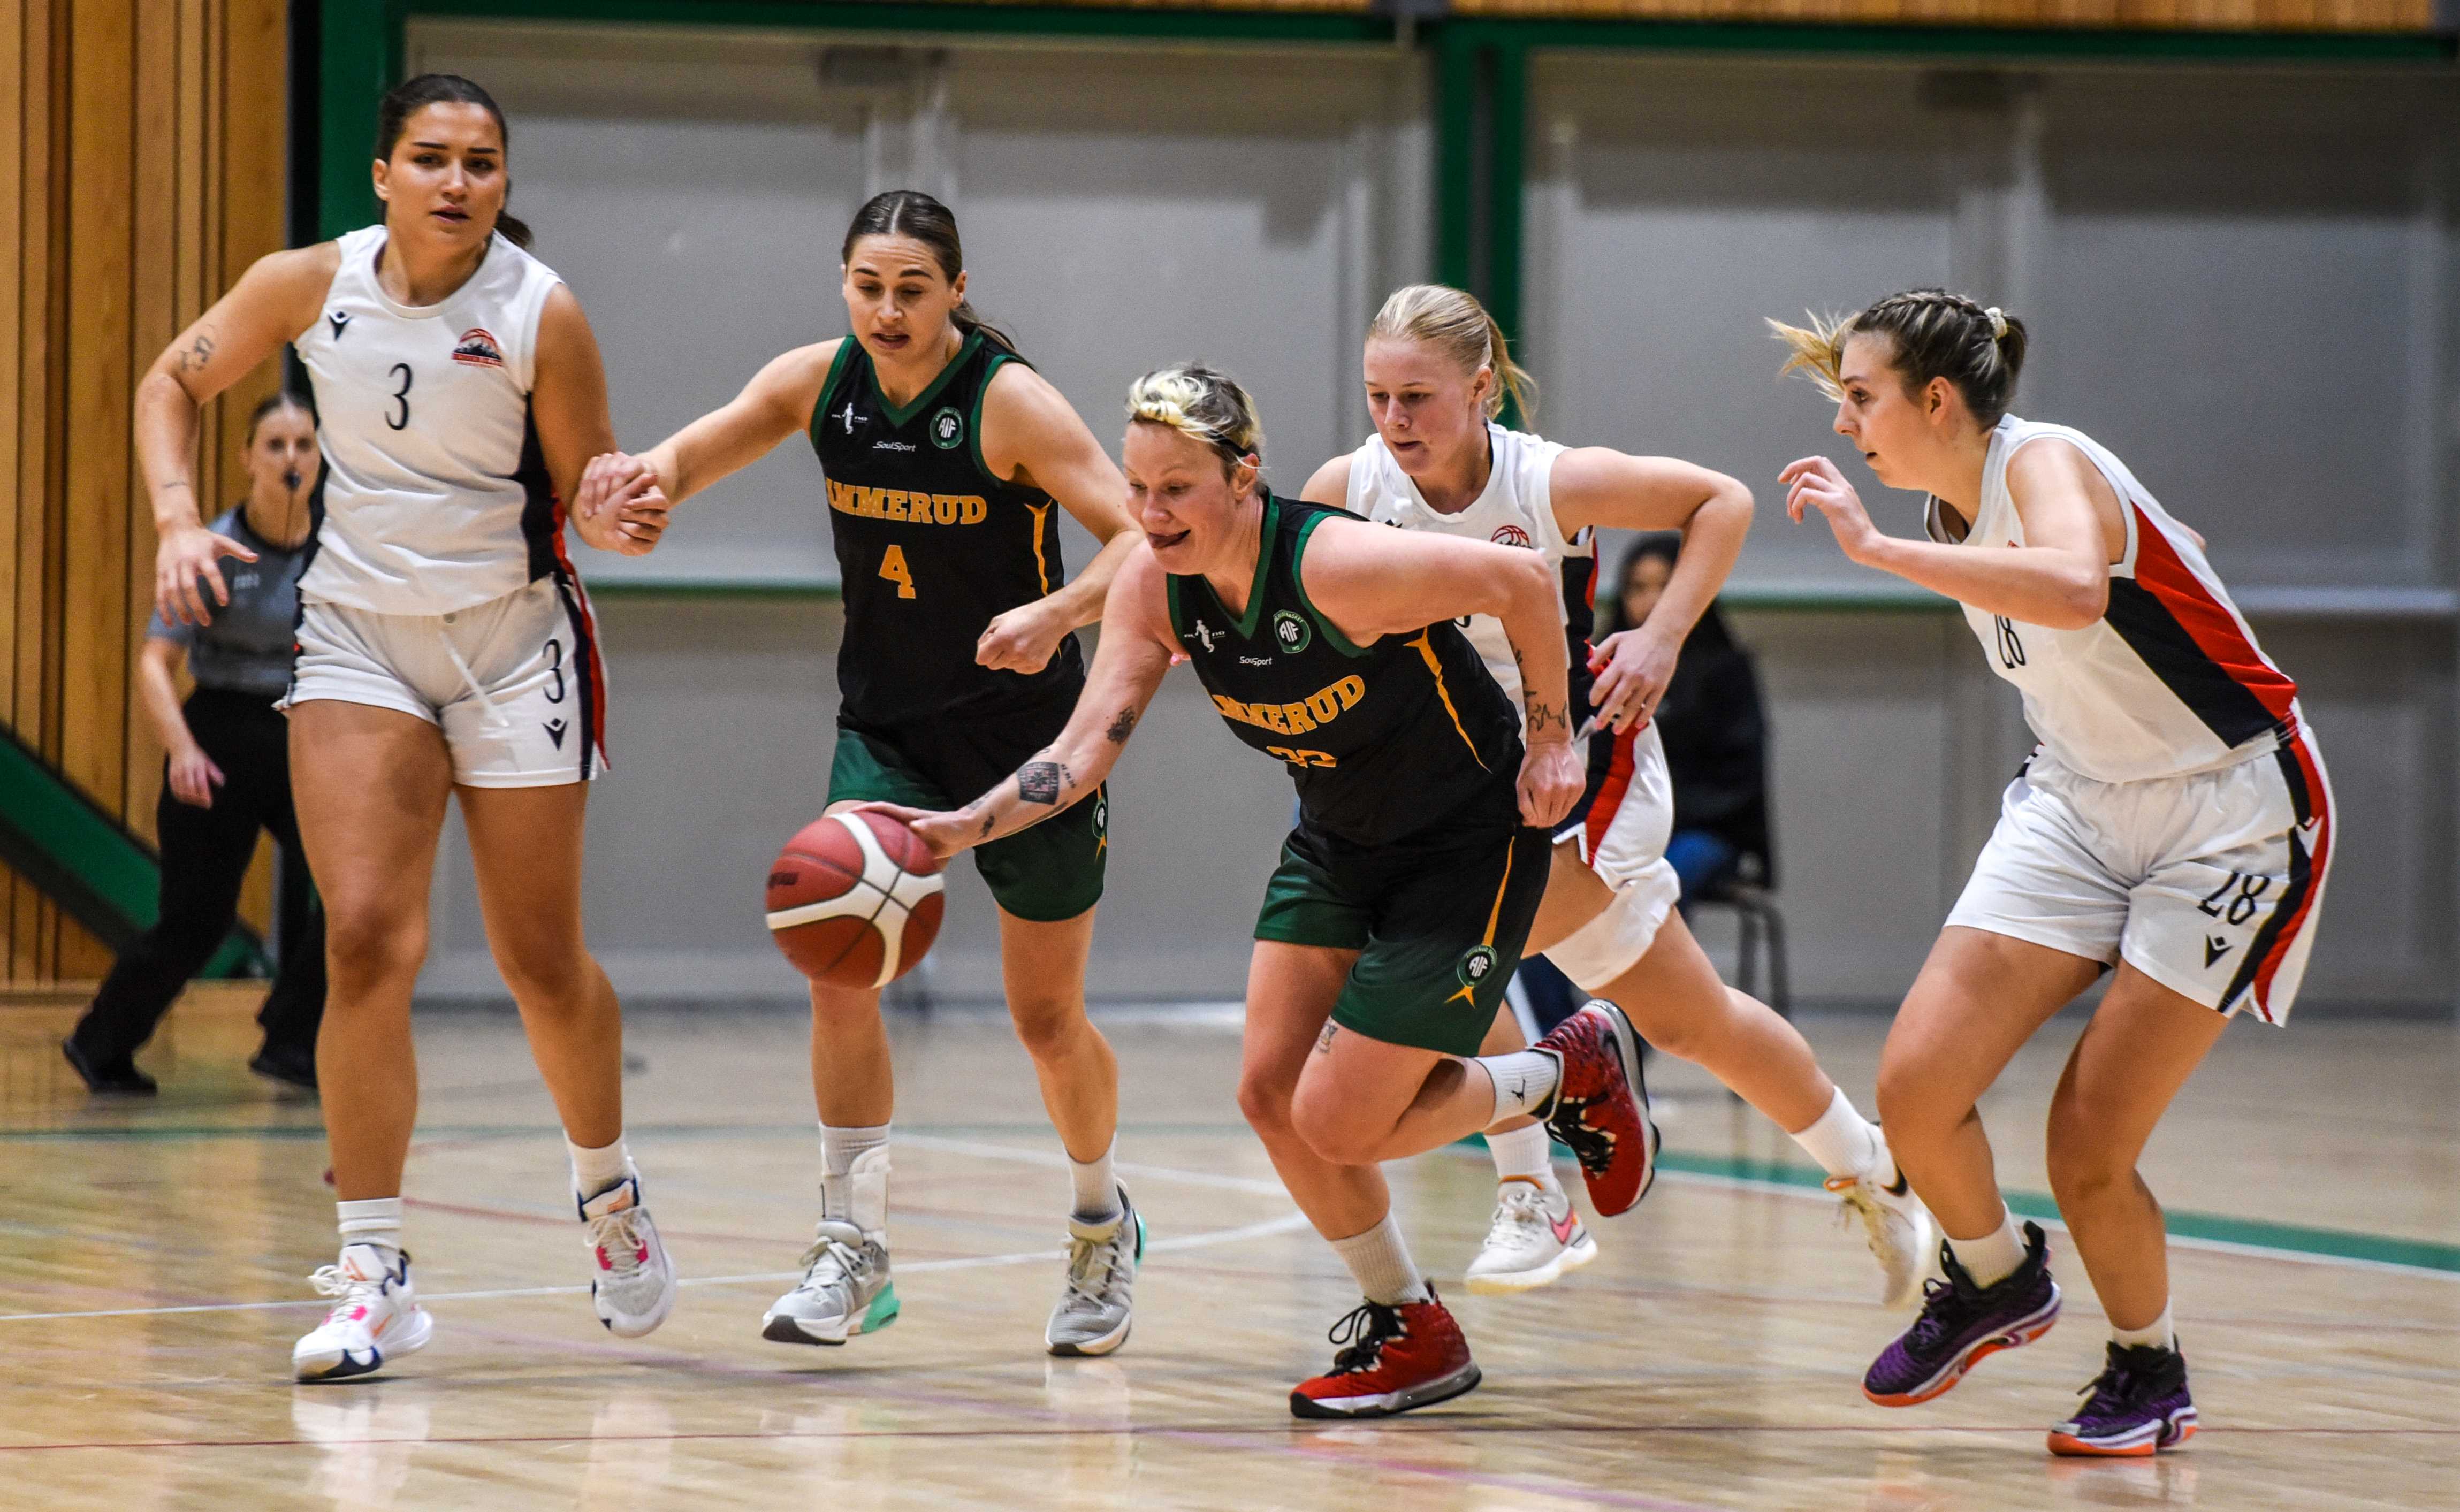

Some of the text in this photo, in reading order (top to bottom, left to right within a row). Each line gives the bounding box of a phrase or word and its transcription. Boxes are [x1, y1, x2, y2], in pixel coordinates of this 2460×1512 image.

[385, 362, 412, 431] 3
[872, 441, 916, 452] SoulSport
[878, 544, 916, 599] 4
[542, 639, 564, 704] 3
[1210, 674, 1365, 735] MMERUD
[2196, 871, 2271, 926] 28
